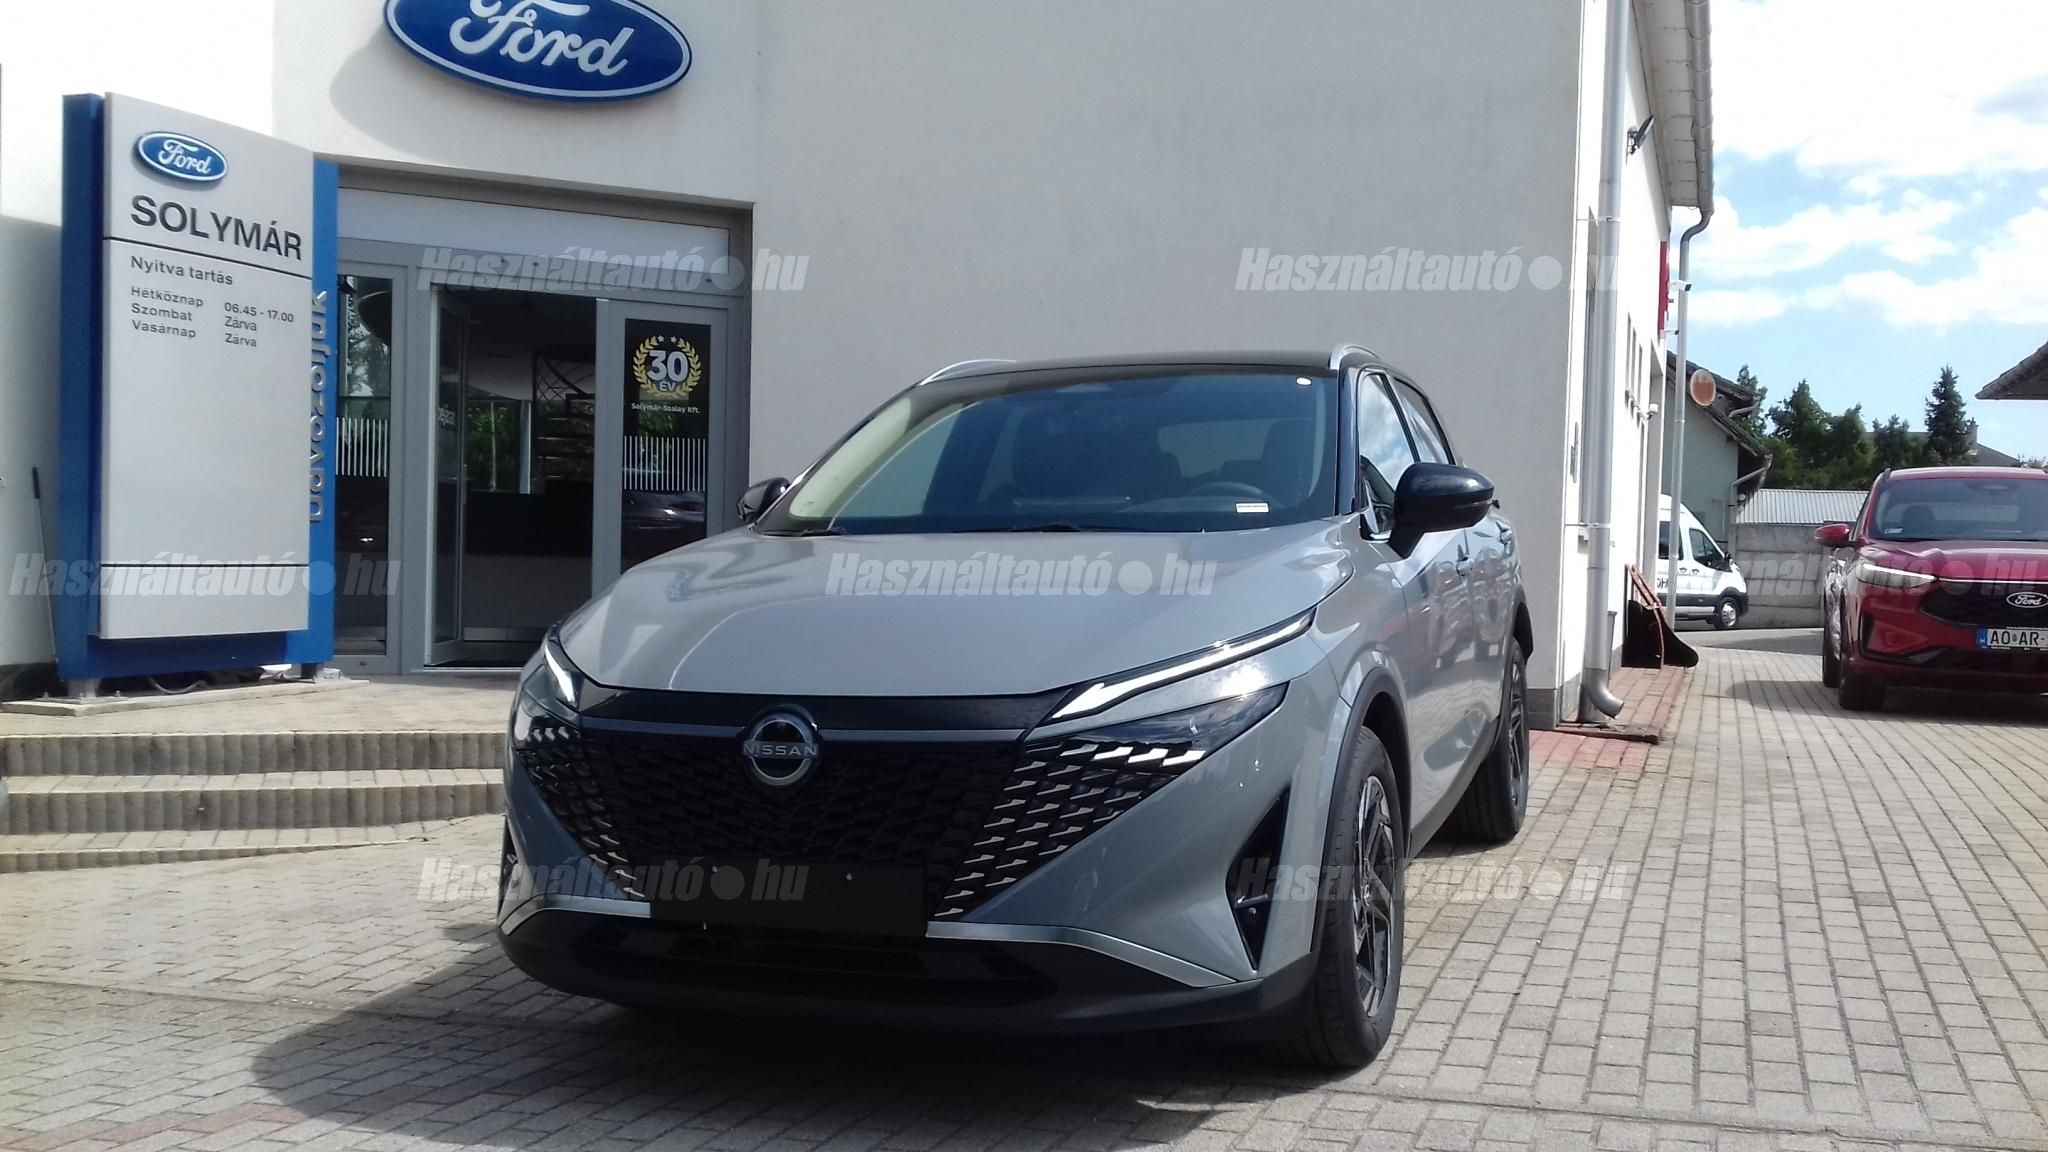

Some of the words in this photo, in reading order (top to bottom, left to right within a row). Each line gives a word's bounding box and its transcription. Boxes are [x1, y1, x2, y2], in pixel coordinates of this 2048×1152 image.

[450, 0, 634, 76] Ford
[158, 139, 211, 174] Ford
[130, 195, 302, 261] SOLYMÁR
[131, 256, 185, 277] Nyitva
[189, 266, 233, 285] tartás
[131, 303, 193, 322] Szombat
[224, 316, 257, 332] Zárva
[224, 302, 257, 316] 06.45
[267, 310, 294, 323] 17.00
[131, 320, 196, 339] Vasárnap
[225, 333, 257, 348] Zárva
[647, 350, 689, 382] 30
[2015, 594, 2042, 606] Ford
[744, 743, 817, 756] NISSAN
